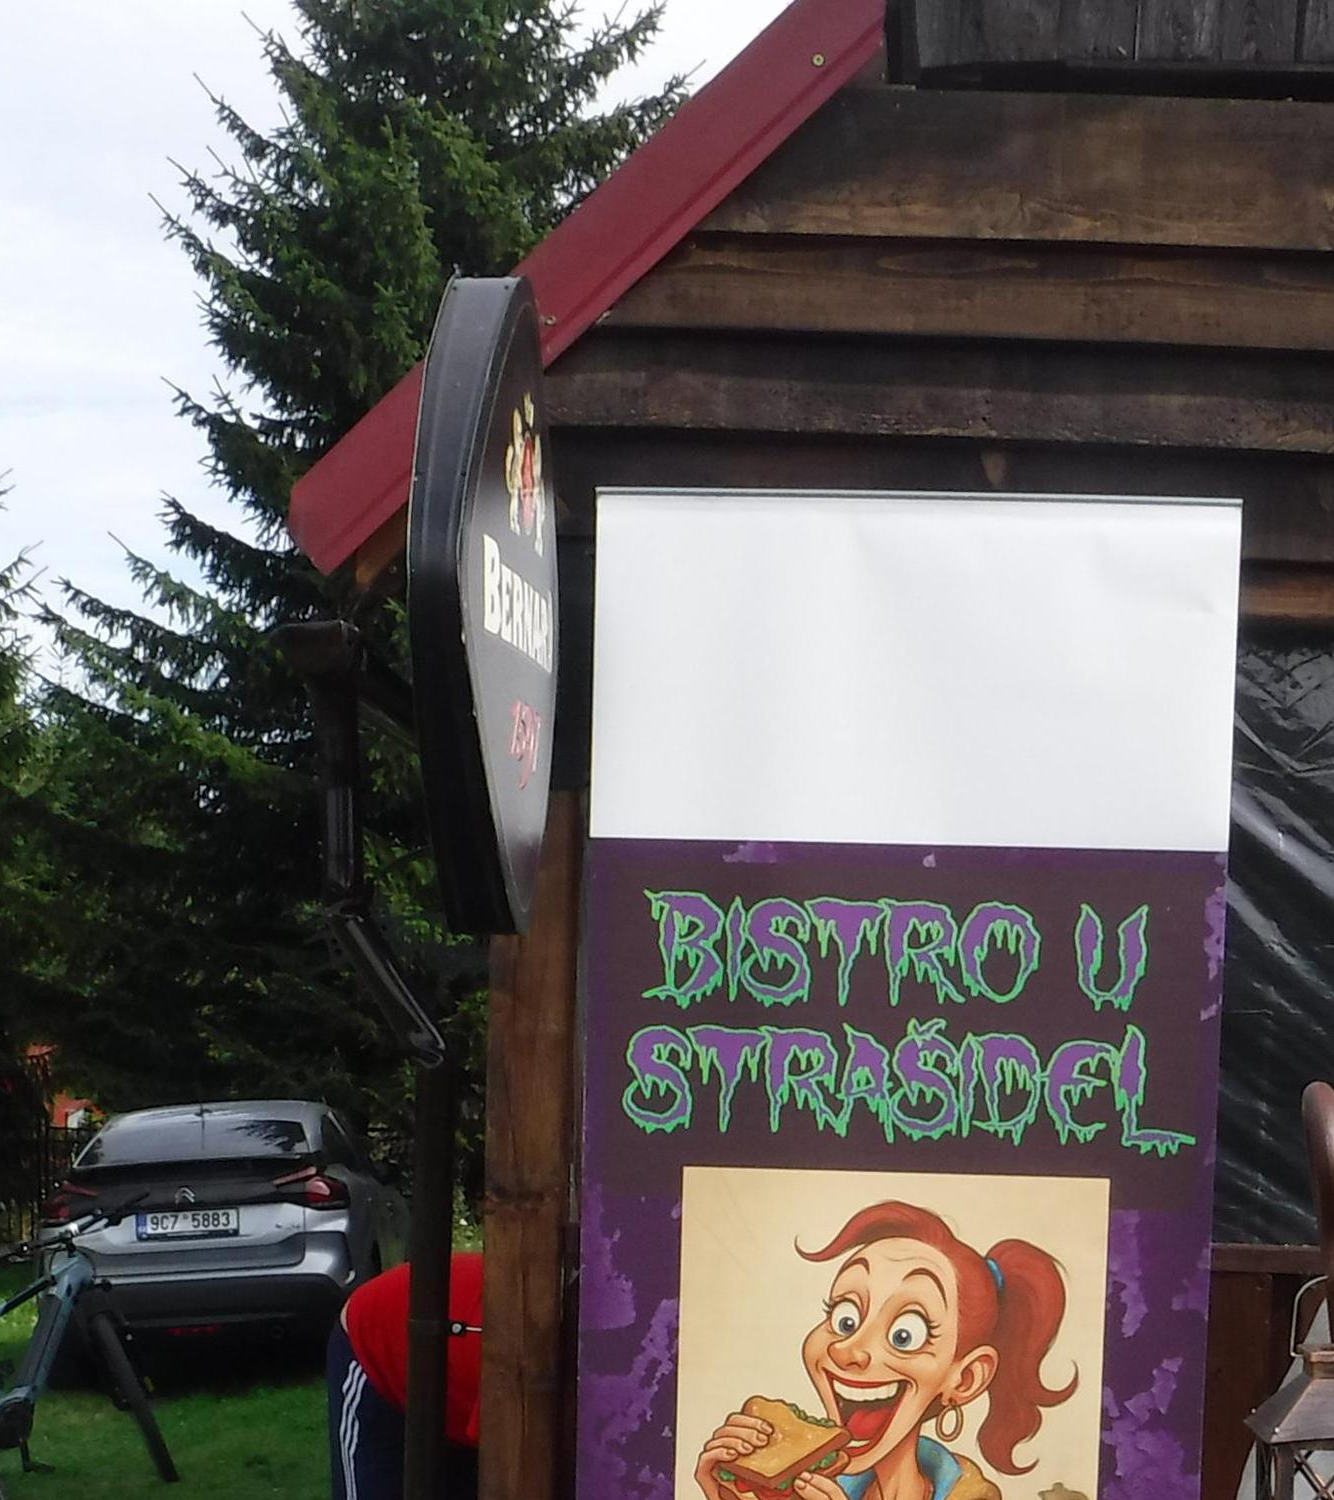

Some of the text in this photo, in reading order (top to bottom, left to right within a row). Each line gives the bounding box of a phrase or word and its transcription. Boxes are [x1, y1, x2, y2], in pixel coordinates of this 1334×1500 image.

[642, 889, 1149, 1010] BISTRO U
[622, 1017, 1196, 1157] STRAŠIDEL
[150, 1211, 231, 1231] 9C7 5883
